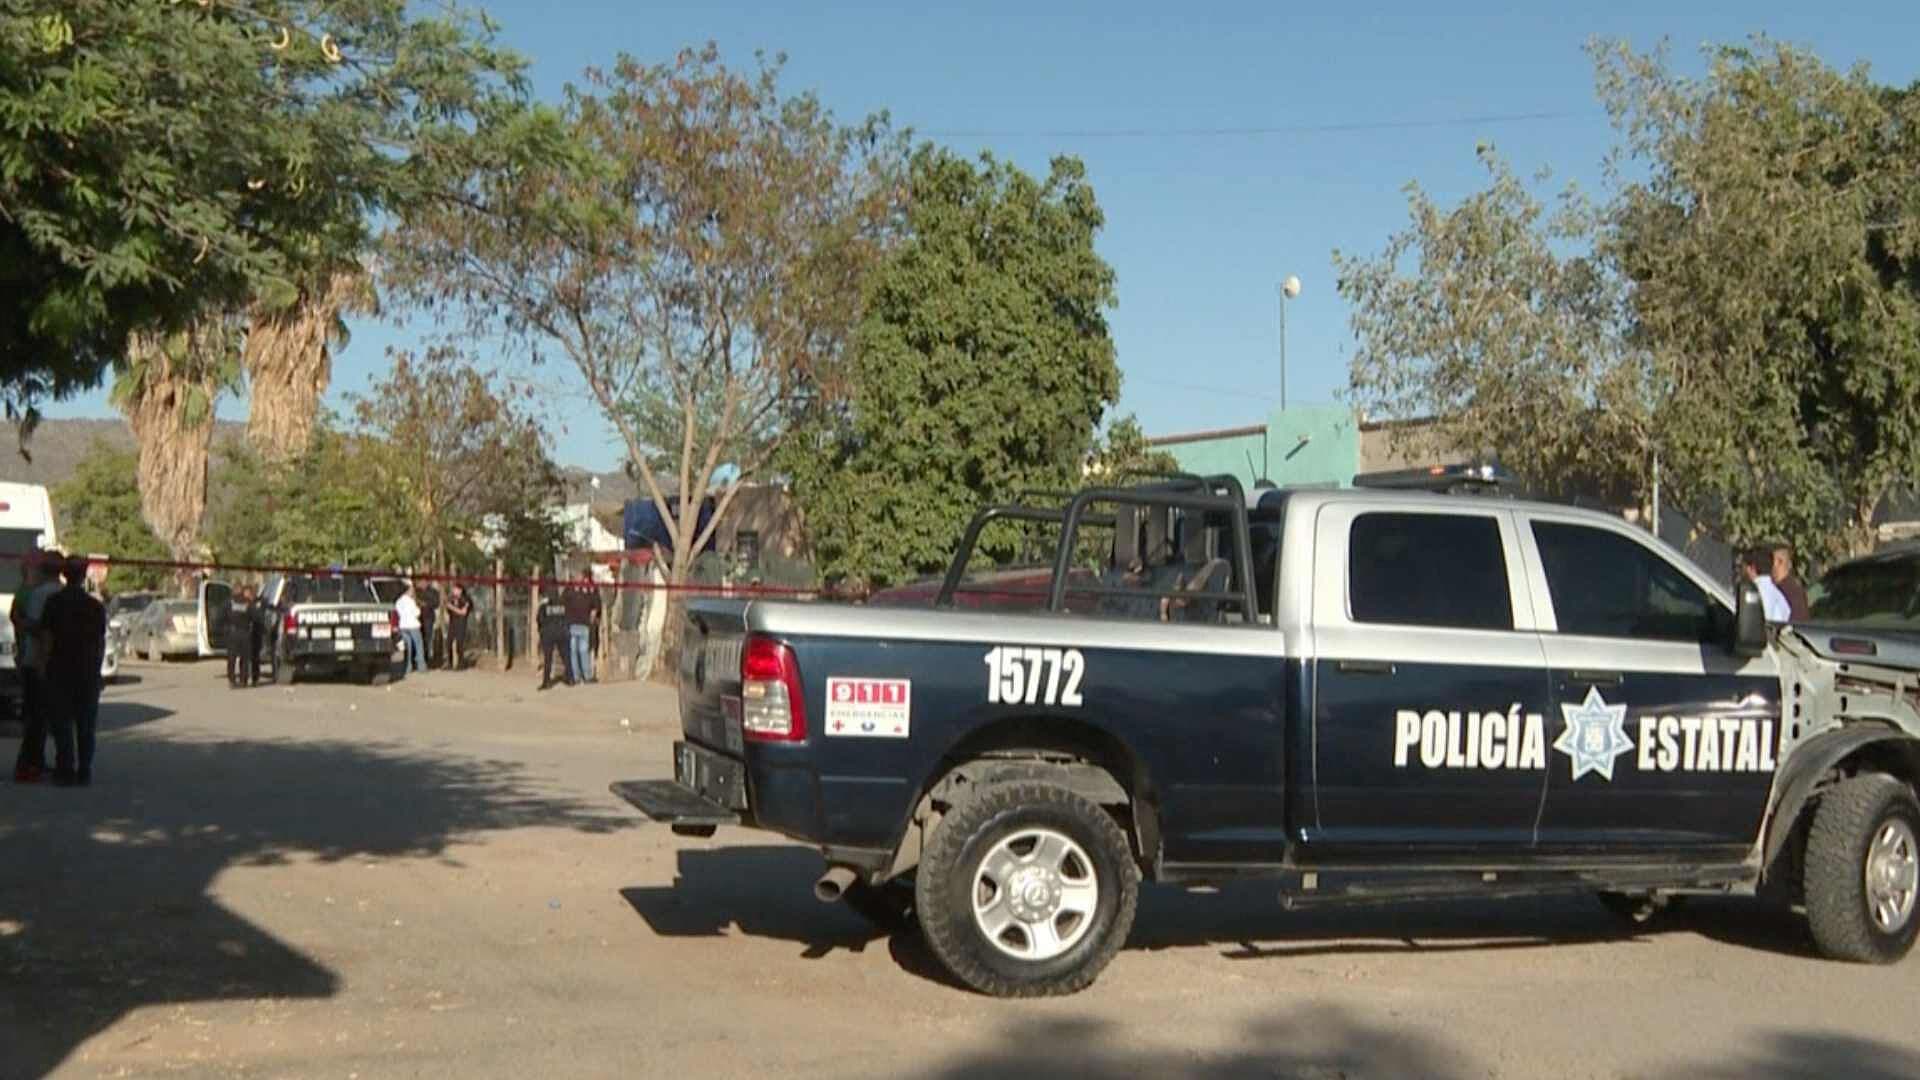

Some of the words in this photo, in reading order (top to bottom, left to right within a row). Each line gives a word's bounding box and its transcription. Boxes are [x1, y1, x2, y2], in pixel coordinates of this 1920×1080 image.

[833, 682, 903, 703] 911
[984, 646, 1084, 705] 15772
[1395, 704, 1545, 769] POLICÍA
[1638, 716, 1774, 771] ESTATAL
